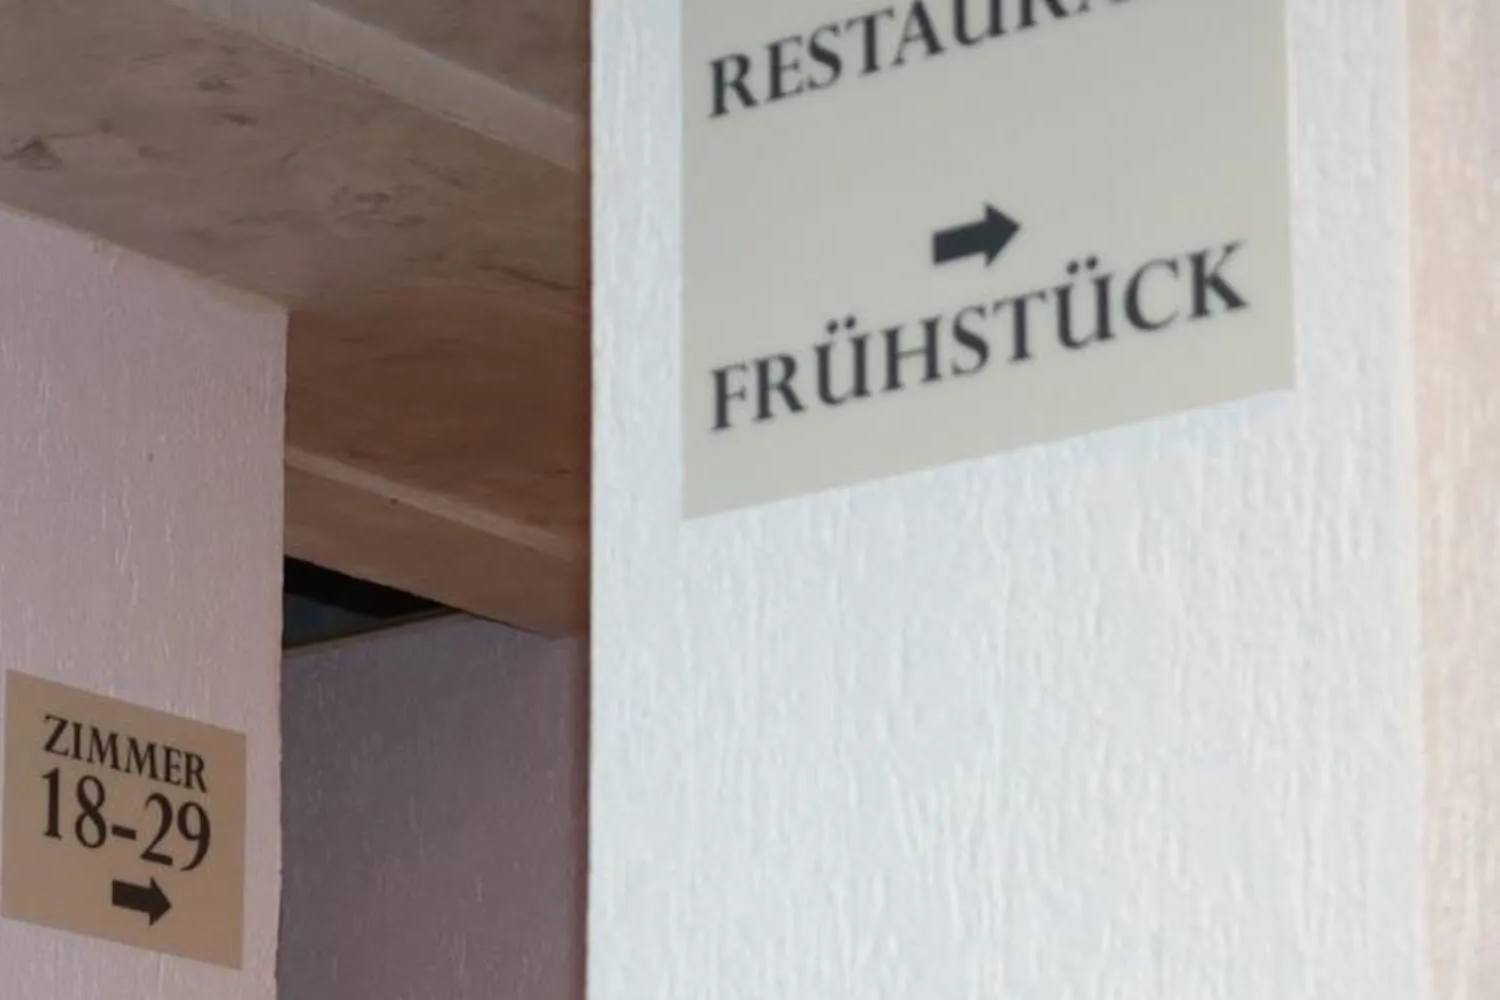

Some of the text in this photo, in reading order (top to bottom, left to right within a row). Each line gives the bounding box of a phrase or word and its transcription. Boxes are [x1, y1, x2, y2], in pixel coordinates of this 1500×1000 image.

[709, 240, 1250, 432] FRÜHSTÜCK
[43, 713, 208, 793] ZIMMER
[41, 767, 212, 872] 18-29
